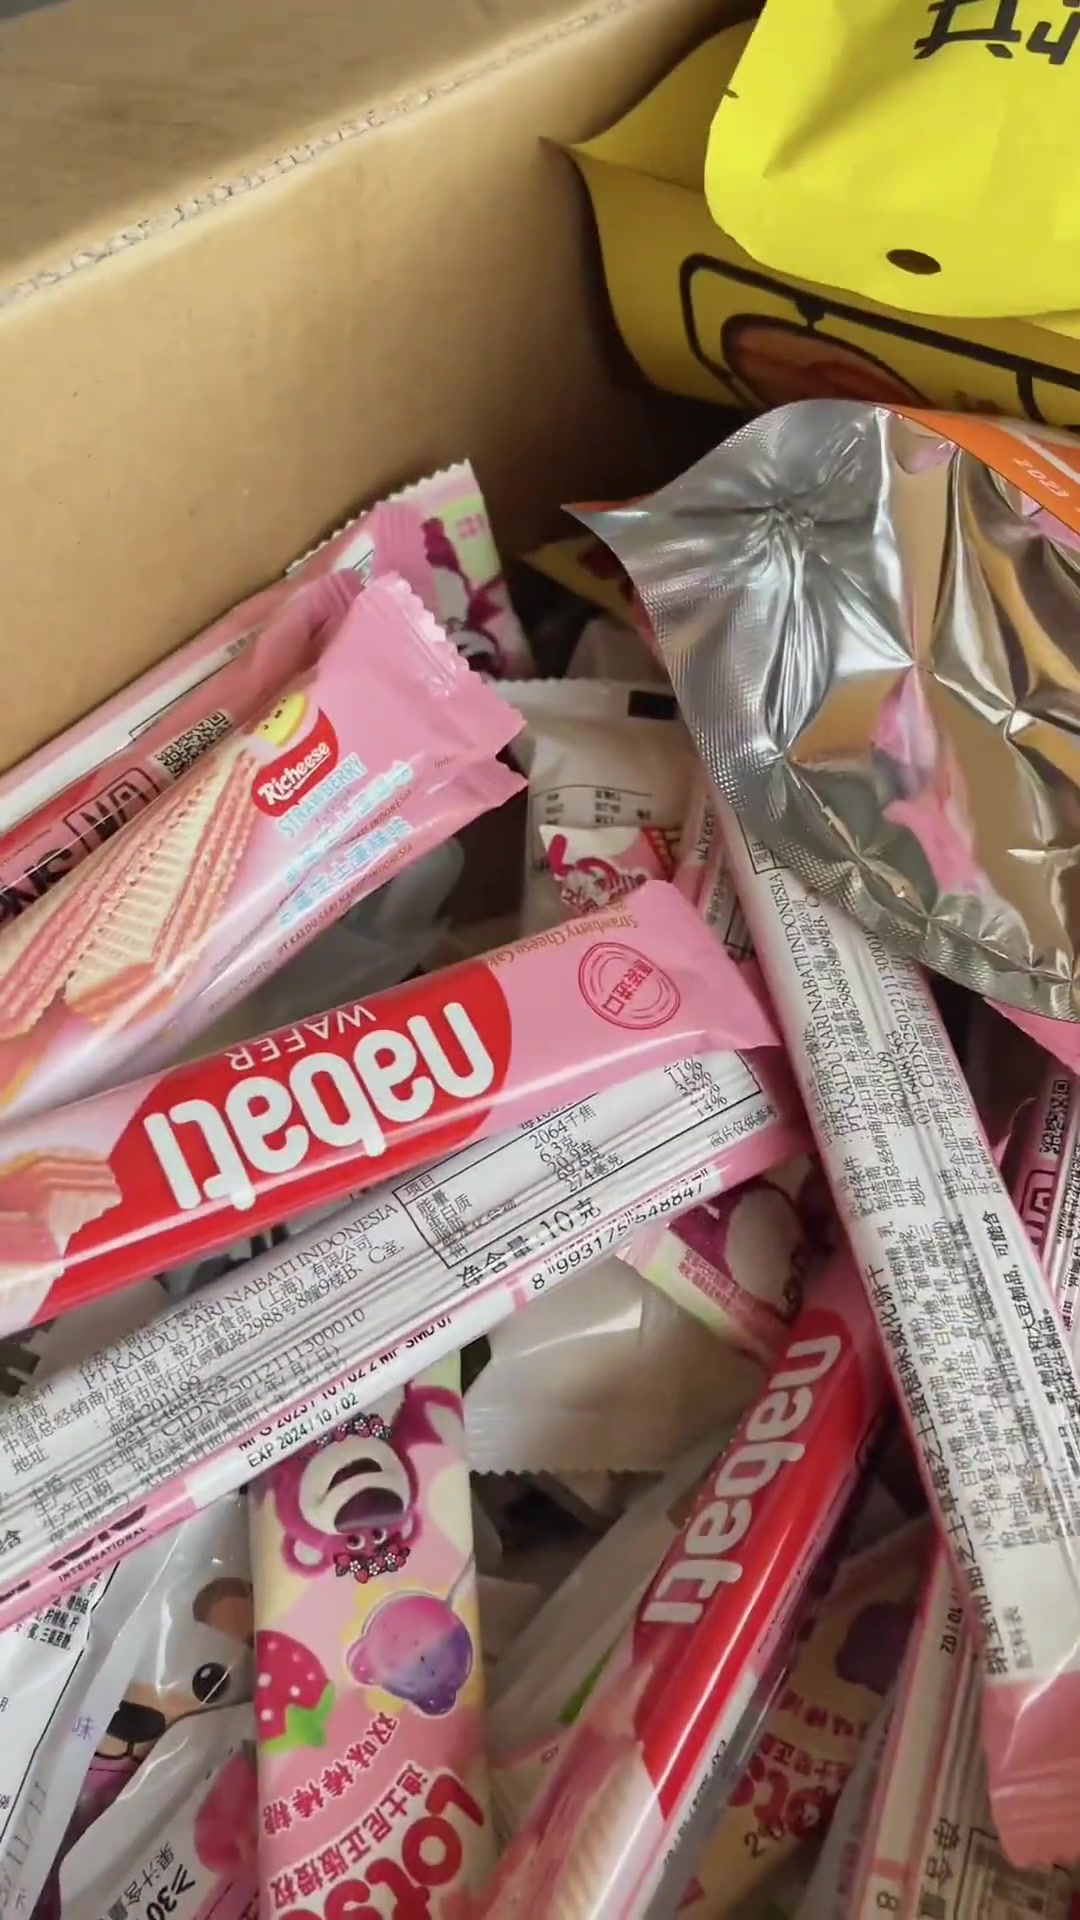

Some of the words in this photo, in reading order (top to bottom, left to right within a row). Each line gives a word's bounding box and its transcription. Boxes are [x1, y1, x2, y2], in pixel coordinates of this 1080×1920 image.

[256, 738, 331, 808] Richeese
[767, 872, 806, 955] INDONESIA
[793, 954, 826, 1013] NABATI
[222, 998, 378, 1074] WAFER
[811, 1012, 838, 1052] SARI
[141, 999, 499, 1208] nabati
[823, 1049, 859, 1110] KALDU
[404, 1173, 435, 1198] 项目
[415, 1188, 449, 1216] 能量
[527, 1101, 597, 1149] 2064千焦
[424, 1192, 472, 1230] 蛋白质
[537, 1132, 578, 1163] 6.3克
[564, 1150, 624, 1192] 274毫克
[864, 1164, 892, 1212] 制造商
[903, 1175, 927, 1208] 地址
[432, 1215, 465, 1242] 脂肪
[109, 1324, 182, 1374] KALDU
[179, 1300, 224, 1334] SARI
[225, 1259, 296, 1307] NABATI
[297, 1200, 398, 1266] INDONESIA
[8, 1442, 50, 1476] 地址
[245, 1440, 276, 1468] EXP
[643, 1335, 841, 1623] nabati
[57, 1524, 147, 1583] INTERNATIONAL
[263, 1711, 399, 1836] 双味棒棒糖
[268, 1761, 429, 1910] 迪士尼正版授权
